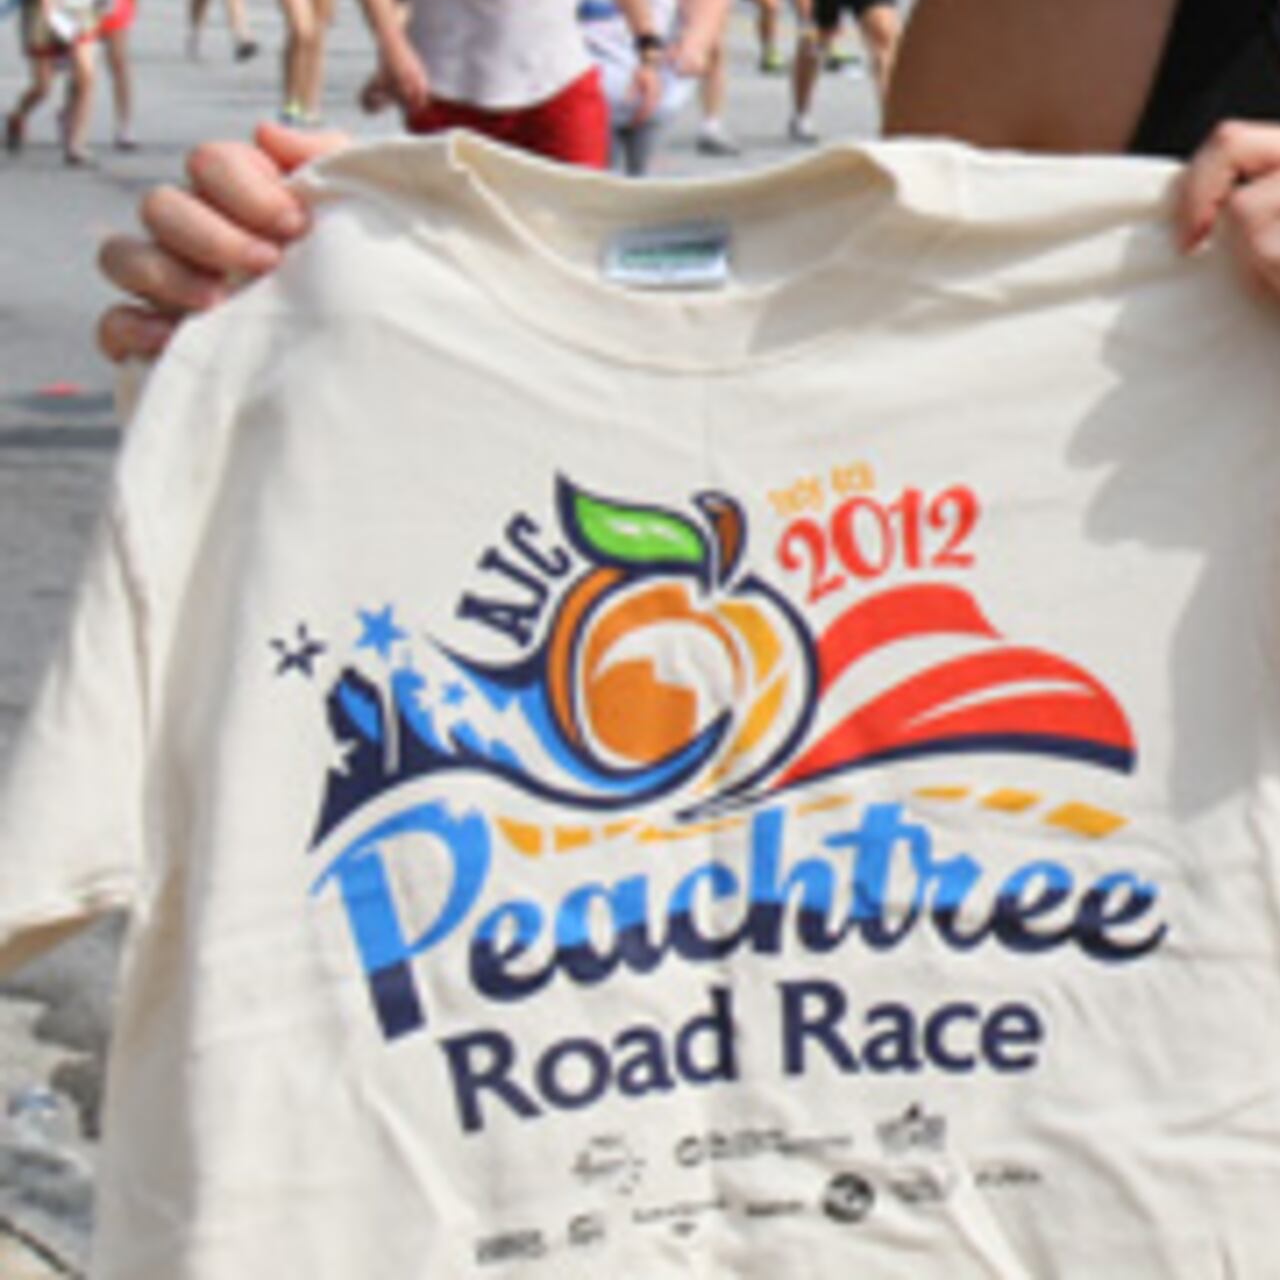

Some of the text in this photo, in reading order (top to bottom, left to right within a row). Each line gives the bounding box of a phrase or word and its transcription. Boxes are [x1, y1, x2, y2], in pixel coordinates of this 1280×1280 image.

[455, 512, 572, 647] AJC
[776, 484, 980, 604] 2012
[310, 799, 1168, 1042] Peachtree
[439, 978, 1045, 1135] Road Race
